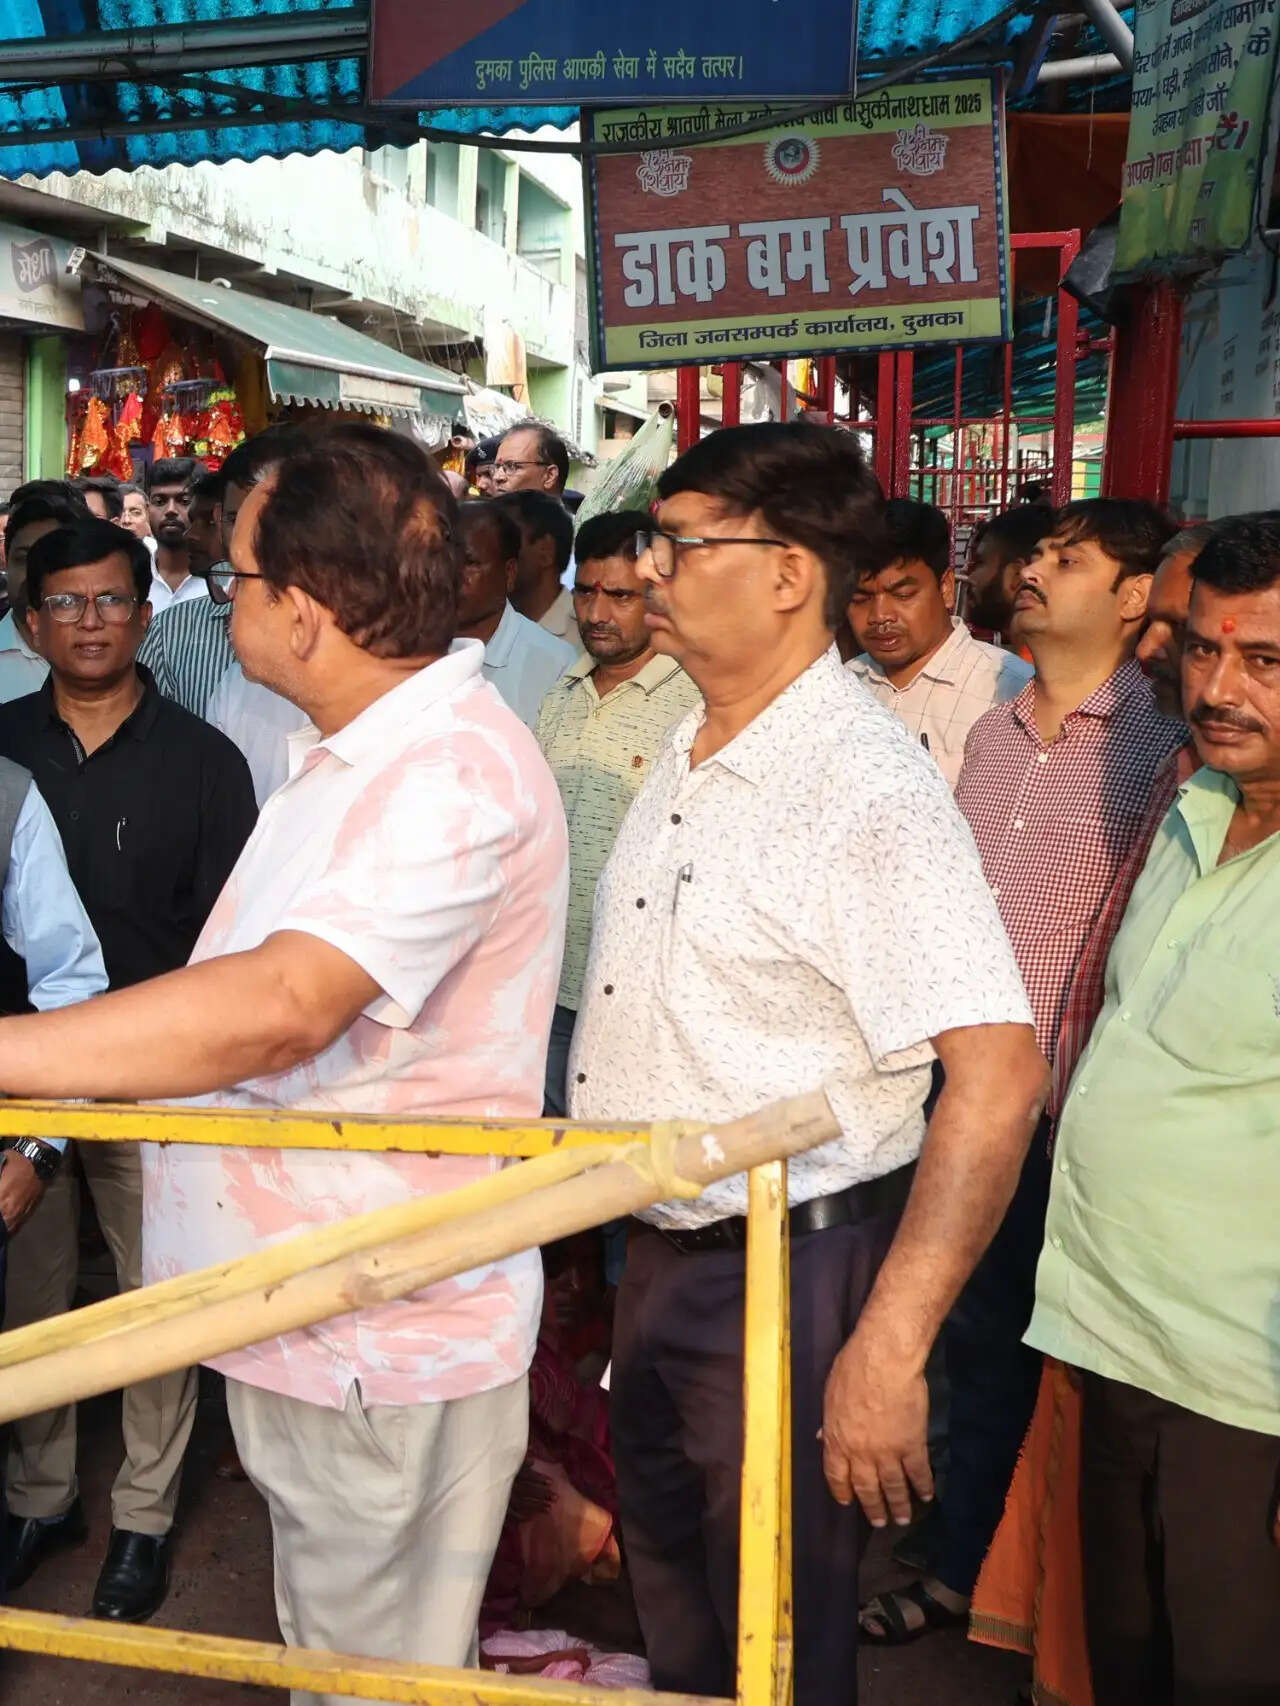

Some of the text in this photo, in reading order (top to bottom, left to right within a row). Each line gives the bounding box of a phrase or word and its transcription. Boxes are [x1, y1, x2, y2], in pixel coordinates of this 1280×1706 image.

[475, 57, 513, 89] दुमका
[519, 51, 557, 89] पुलिस
[563, 51, 606, 81] आपकी
[613, 49, 639, 80] सेवा
[646, 49, 658, 79] में
[664, 48, 696, 80] सदैव
[954, 92, 983, 115] 2025
[615, 188, 981, 308] डाक बम प्रवेश
[638, 310, 965, 349] जिला जनसम्पर्क कार्यालय, दुमका
